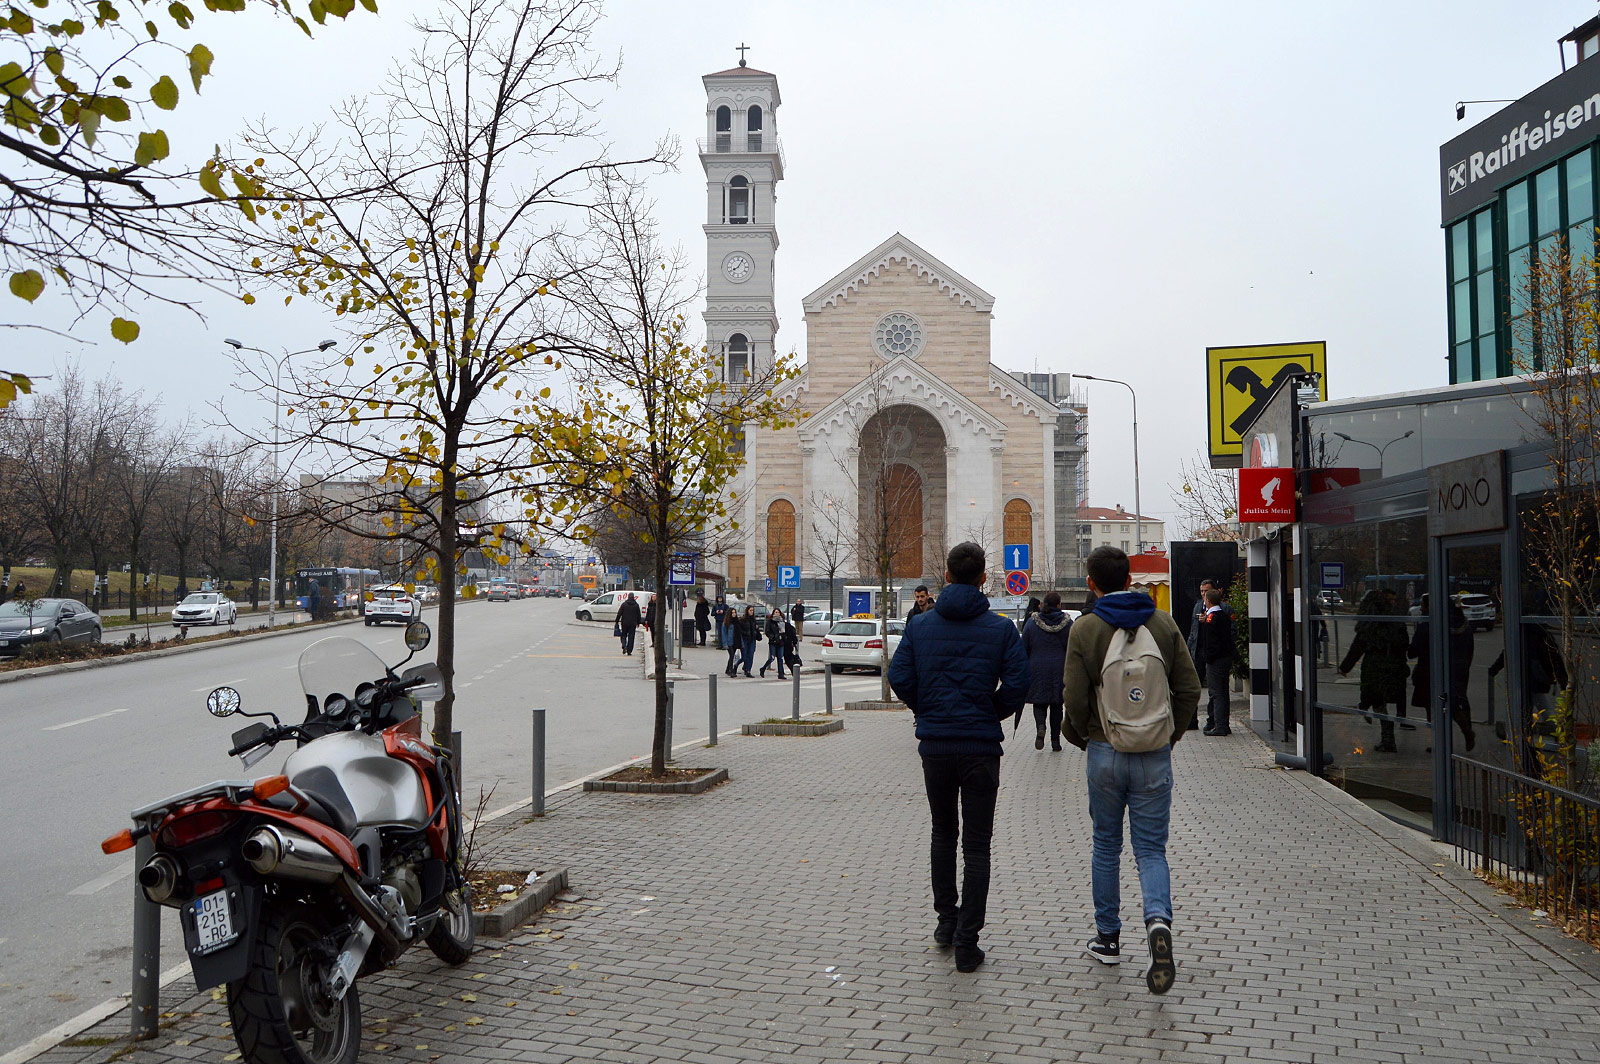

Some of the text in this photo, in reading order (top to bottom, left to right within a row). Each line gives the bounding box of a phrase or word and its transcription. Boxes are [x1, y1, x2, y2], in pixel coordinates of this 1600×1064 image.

[1470, 93, 1600, 184] Raiffeisen
[1244, 507, 1291, 515] Julius Meinl
[781, 567, 795, 586] P
[203, 895, 219, 912] 01
[201, 908, 226, 930] 215
